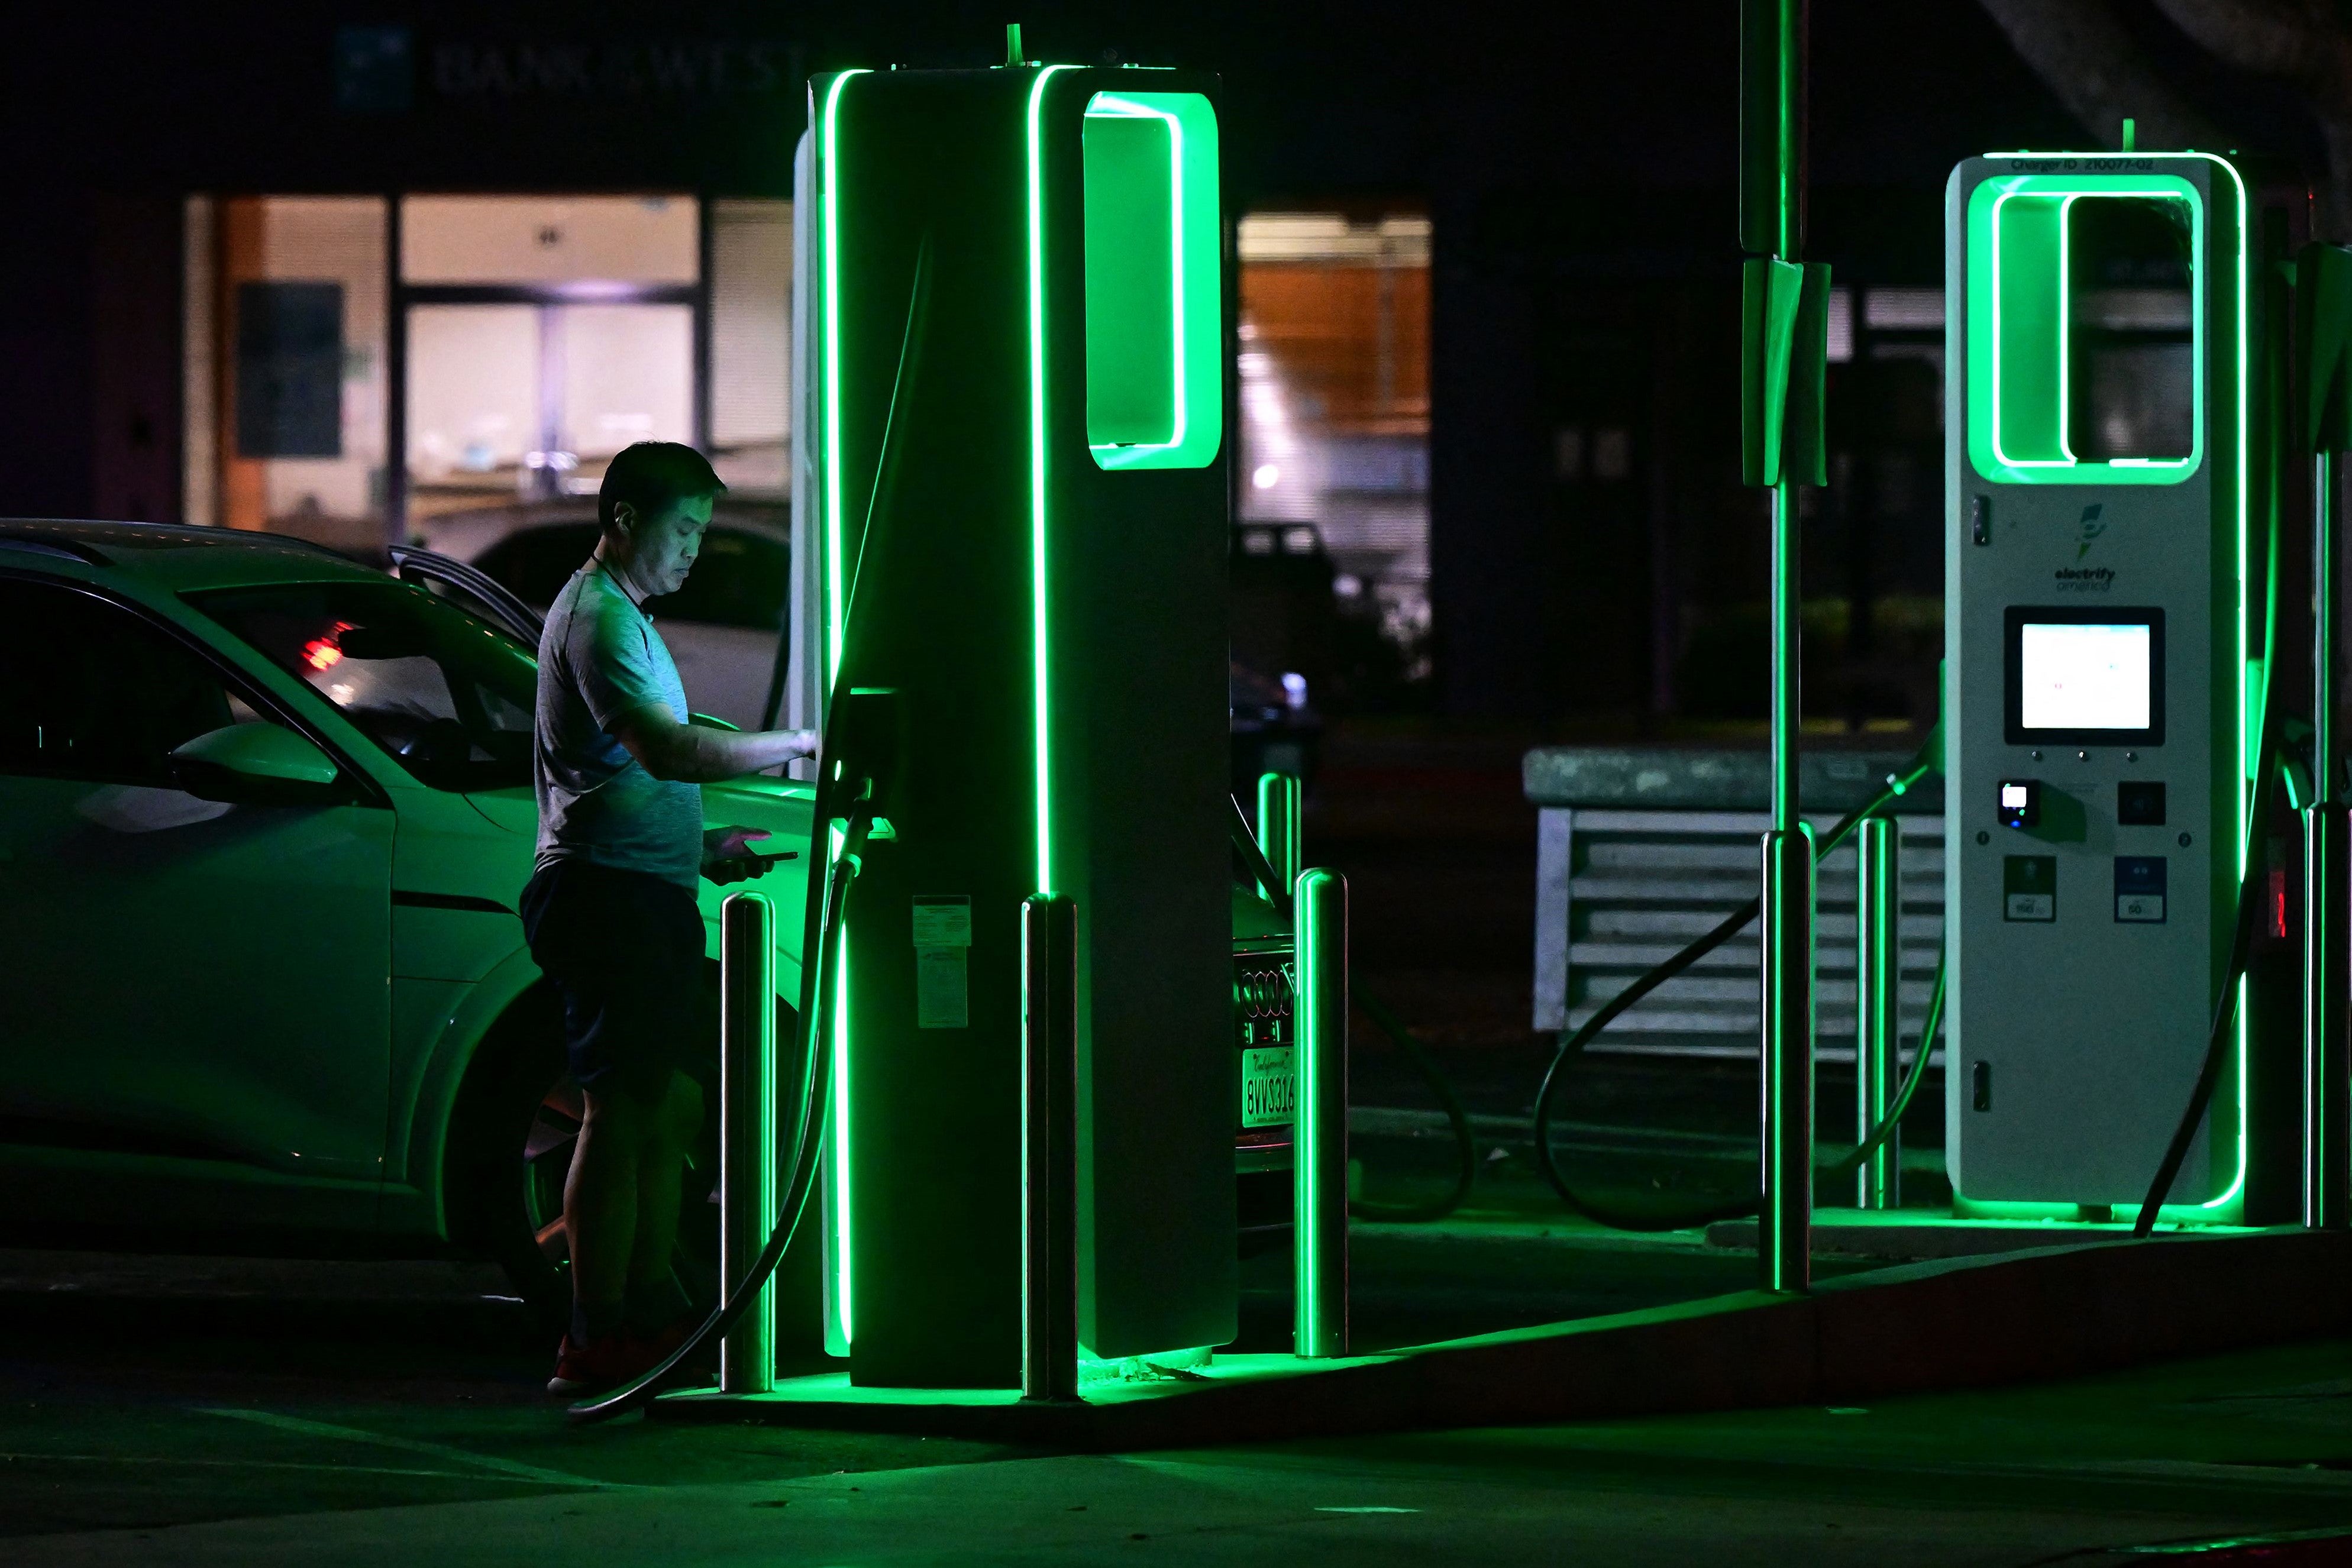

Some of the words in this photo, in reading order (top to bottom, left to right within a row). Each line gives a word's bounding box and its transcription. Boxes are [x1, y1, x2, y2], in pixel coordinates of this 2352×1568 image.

[2064, 159, 2078, 170] ID
[2054, 566, 2116, 582] electrify
[1248, 1076, 1294, 1115] 8VVS316
